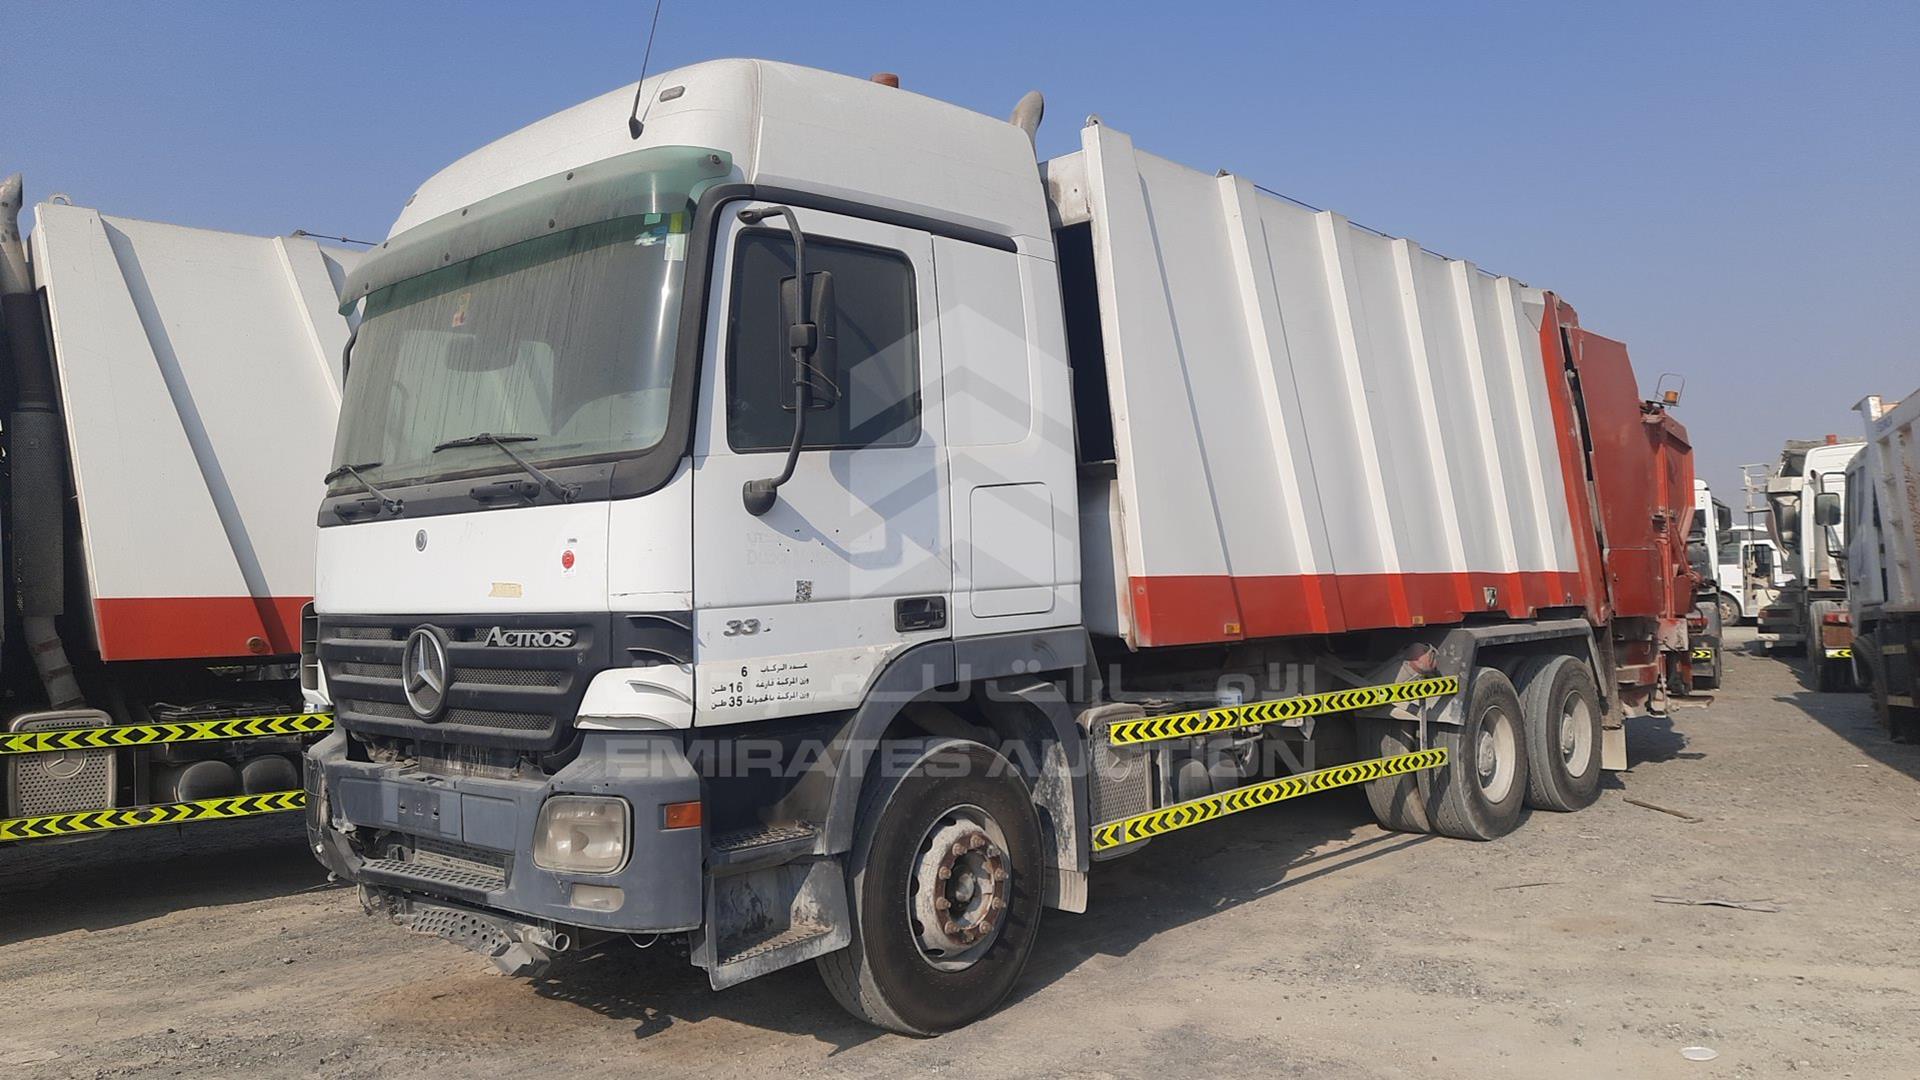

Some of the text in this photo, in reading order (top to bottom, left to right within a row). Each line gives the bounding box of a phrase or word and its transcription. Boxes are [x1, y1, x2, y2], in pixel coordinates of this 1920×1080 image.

[723, 618, 760, 637] 33
[741, 666, 748, 677] 6
[728, 682, 743, 693] 16
[728, 696, 743, 707] 35
